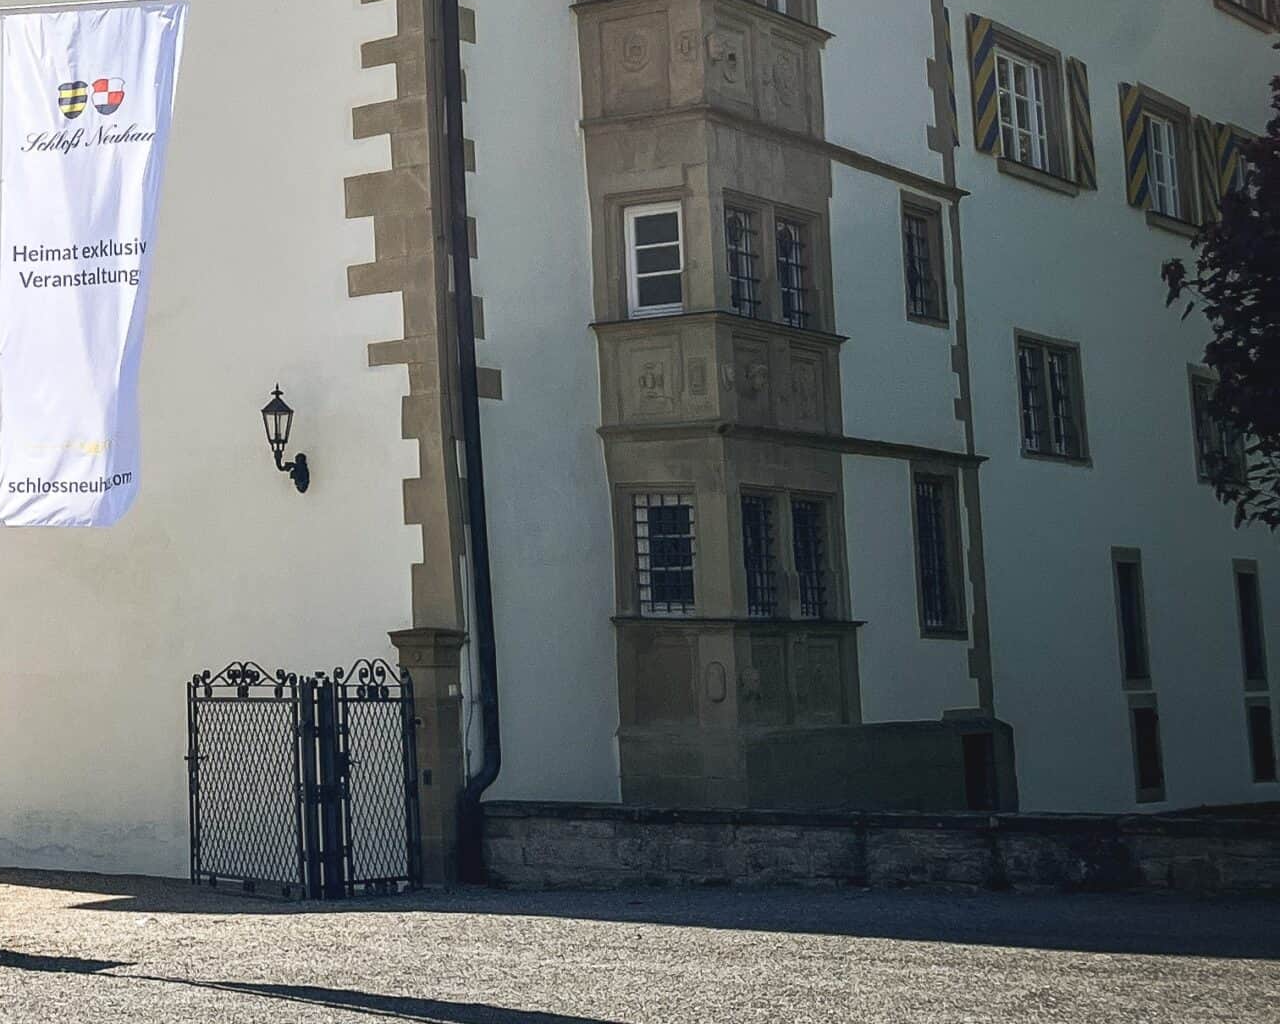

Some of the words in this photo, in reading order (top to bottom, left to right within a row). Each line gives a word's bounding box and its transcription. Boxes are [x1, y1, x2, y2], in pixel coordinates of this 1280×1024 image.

[20, 128, 85, 155] Schloß
[84, 123, 157, 147] Neuhau
[12, 244, 79, 263] Heimat
[81, 237, 147, 259] exklusiv
[19, 266, 140, 289] Veranstaltung
